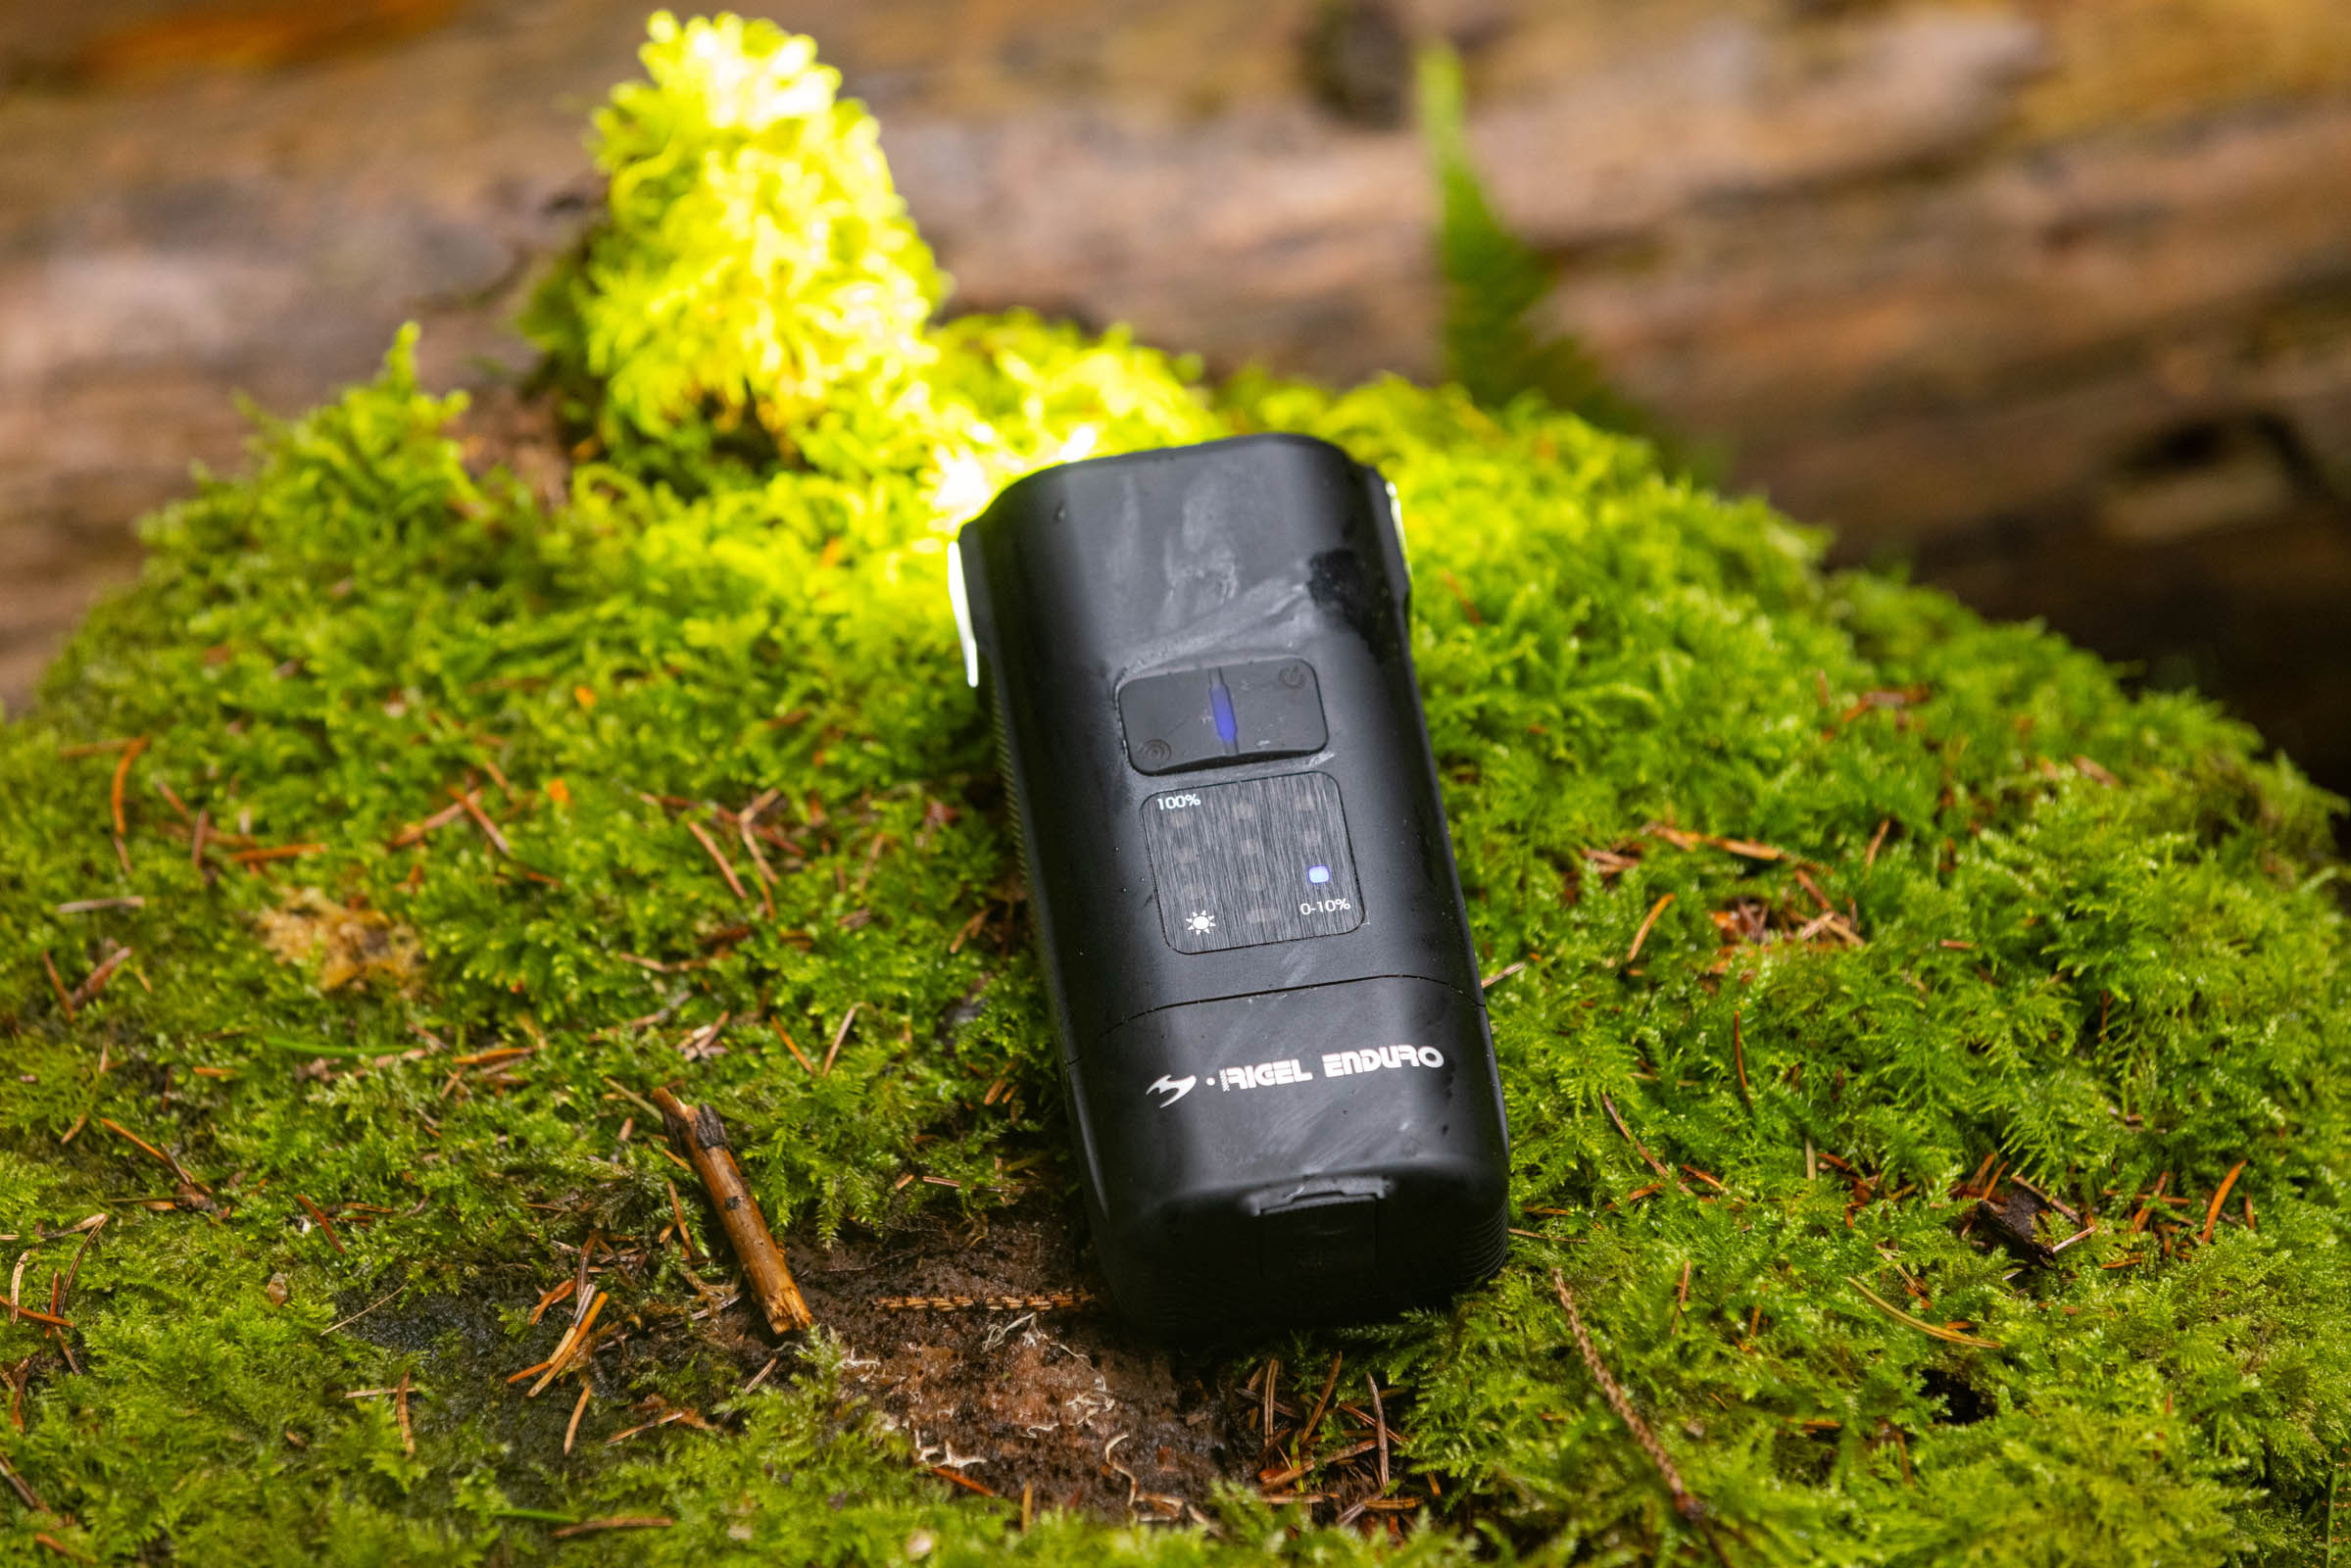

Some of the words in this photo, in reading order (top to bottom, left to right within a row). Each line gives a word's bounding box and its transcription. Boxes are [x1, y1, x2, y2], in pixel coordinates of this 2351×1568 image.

[1156, 793, 1201, 810] 100%
[1299, 898, 1351, 915] 0-10%
[1219, 1058, 1313, 1091] RIGEL
[1321, 1045, 1445, 1078] ENDURO
